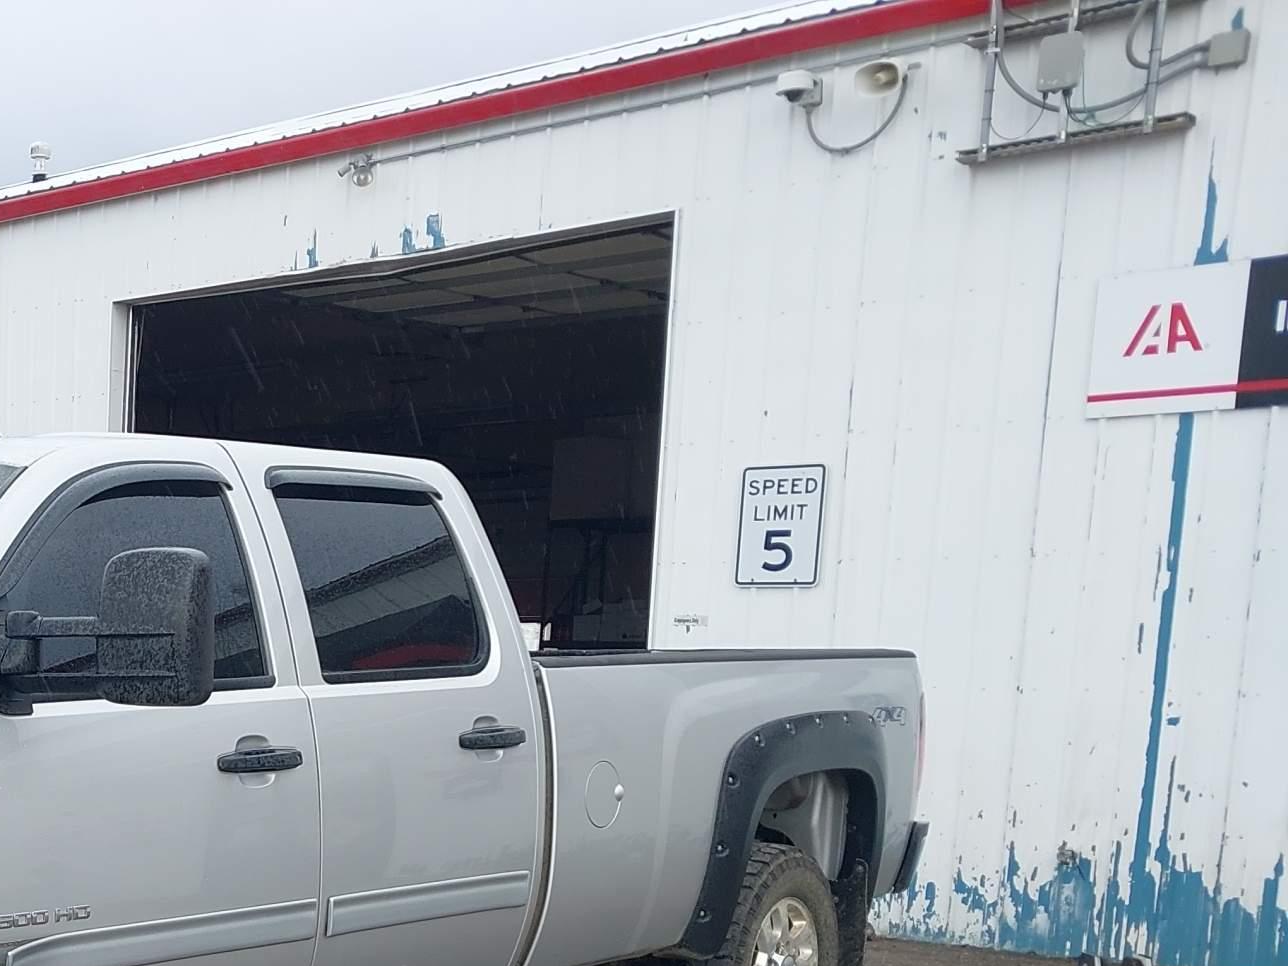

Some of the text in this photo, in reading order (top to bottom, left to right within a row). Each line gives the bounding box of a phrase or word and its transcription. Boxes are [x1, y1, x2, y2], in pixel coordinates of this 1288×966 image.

[748, 477, 818, 496] SPEED
[753, 504, 809, 522] LIMIT
[761, 529, 793, 572] 5
[54, 904, 91, 924] HD
